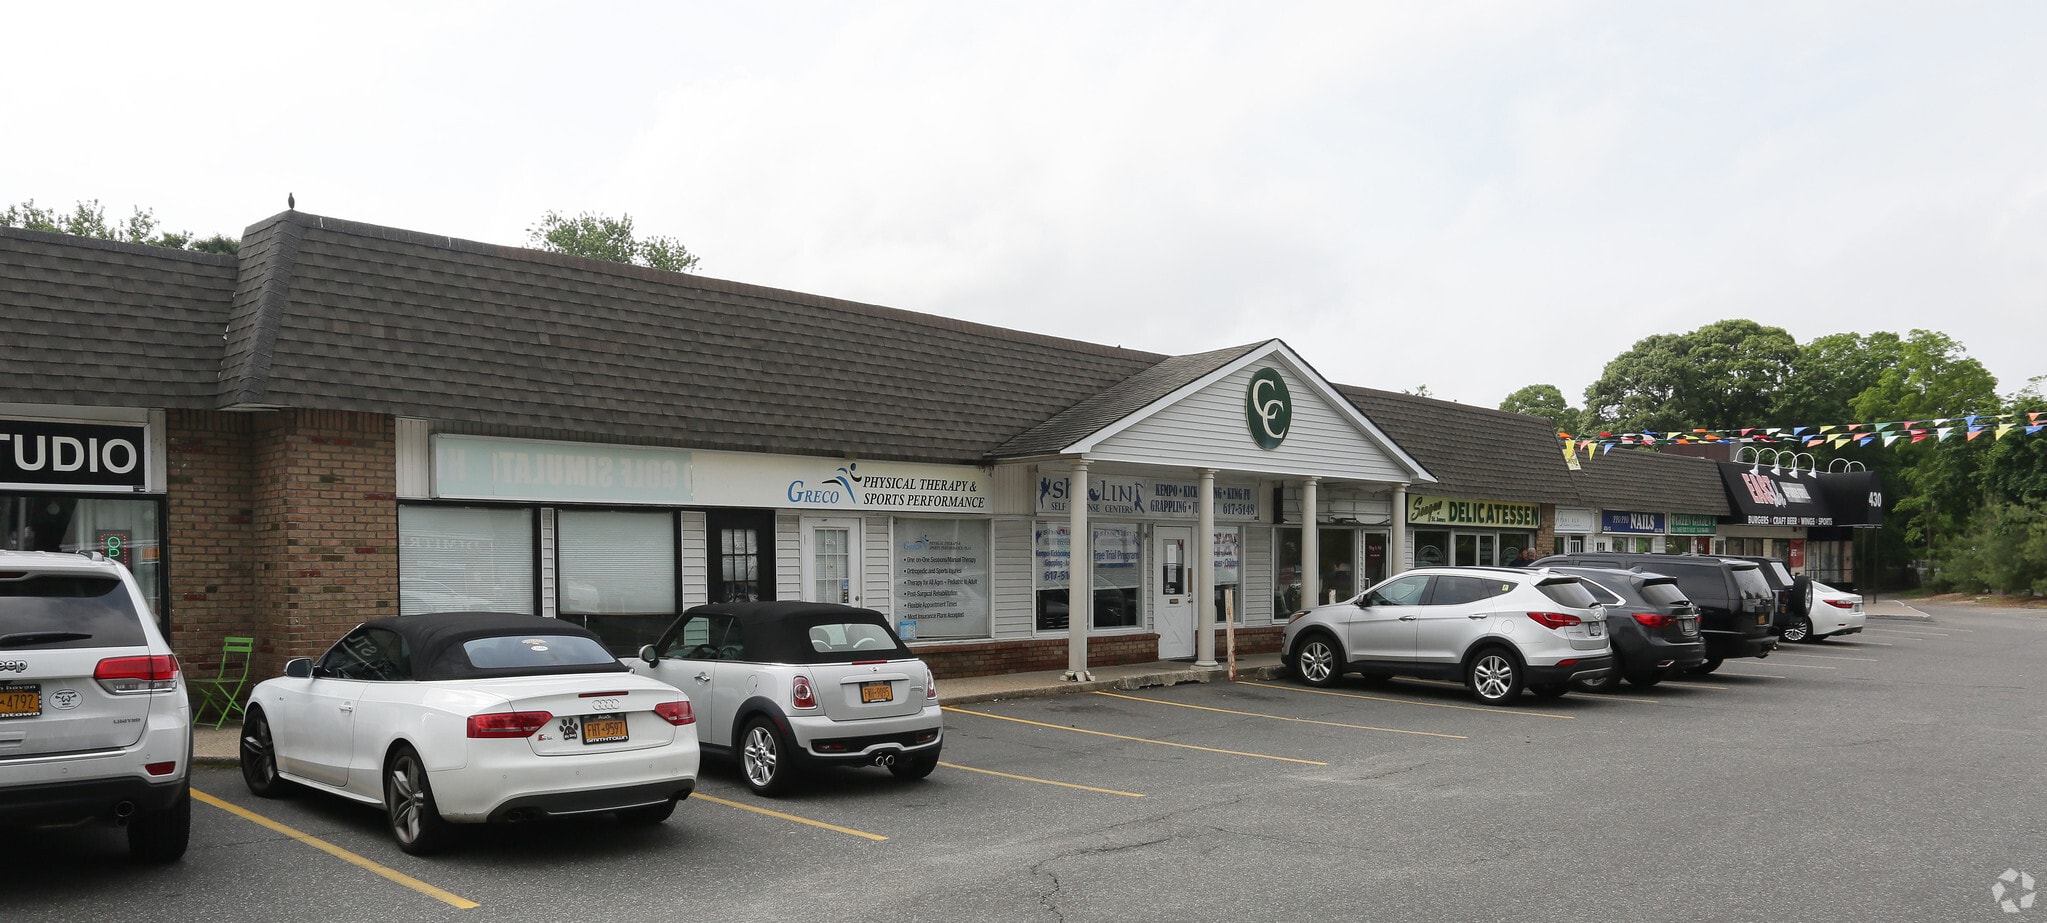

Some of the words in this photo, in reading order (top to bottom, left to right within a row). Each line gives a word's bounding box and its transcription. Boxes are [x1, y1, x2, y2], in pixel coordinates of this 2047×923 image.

[787, 480, 840, 504] GRECO
[862, 476, 917, 490] PHYSICAL
[919, 478, 969, 492] THERAPY
[969, 480, 977, 492] &
[1155, 483, 1178, 497] KEMPO
[863, 492, 905, 506] SPORTS
[906, 494, 985, 508] PERFORMANCE
[1868, 491, 1882, 507] 430
[1051, 502, 1067, 511] SELF
[1104, 504, 1133, 514] CENTERS
[1150, 499, 1187, 514] GRAPPLING
[1223, 503, 1255, 516] 617-5148
[1448, 501, 1539, 525] DELICATESSEN
[1630, 513, 1655, 530] NAILS
[1747, 515, 1769, 524] BURGERS
[1772, 516, 1786, 525] CRAFT
[1787, 516, 1798, 525] BEER
[1800, 517, 1816, 526] WINGS
[1818, 517, 1833, 526] SPORTS
[1093, 550, 1105, 560] Free
[1105, 550, 1117, 560] Trial
[1117, 550, 1139, 562] Program
[6, 694, 34, 710] 4792
